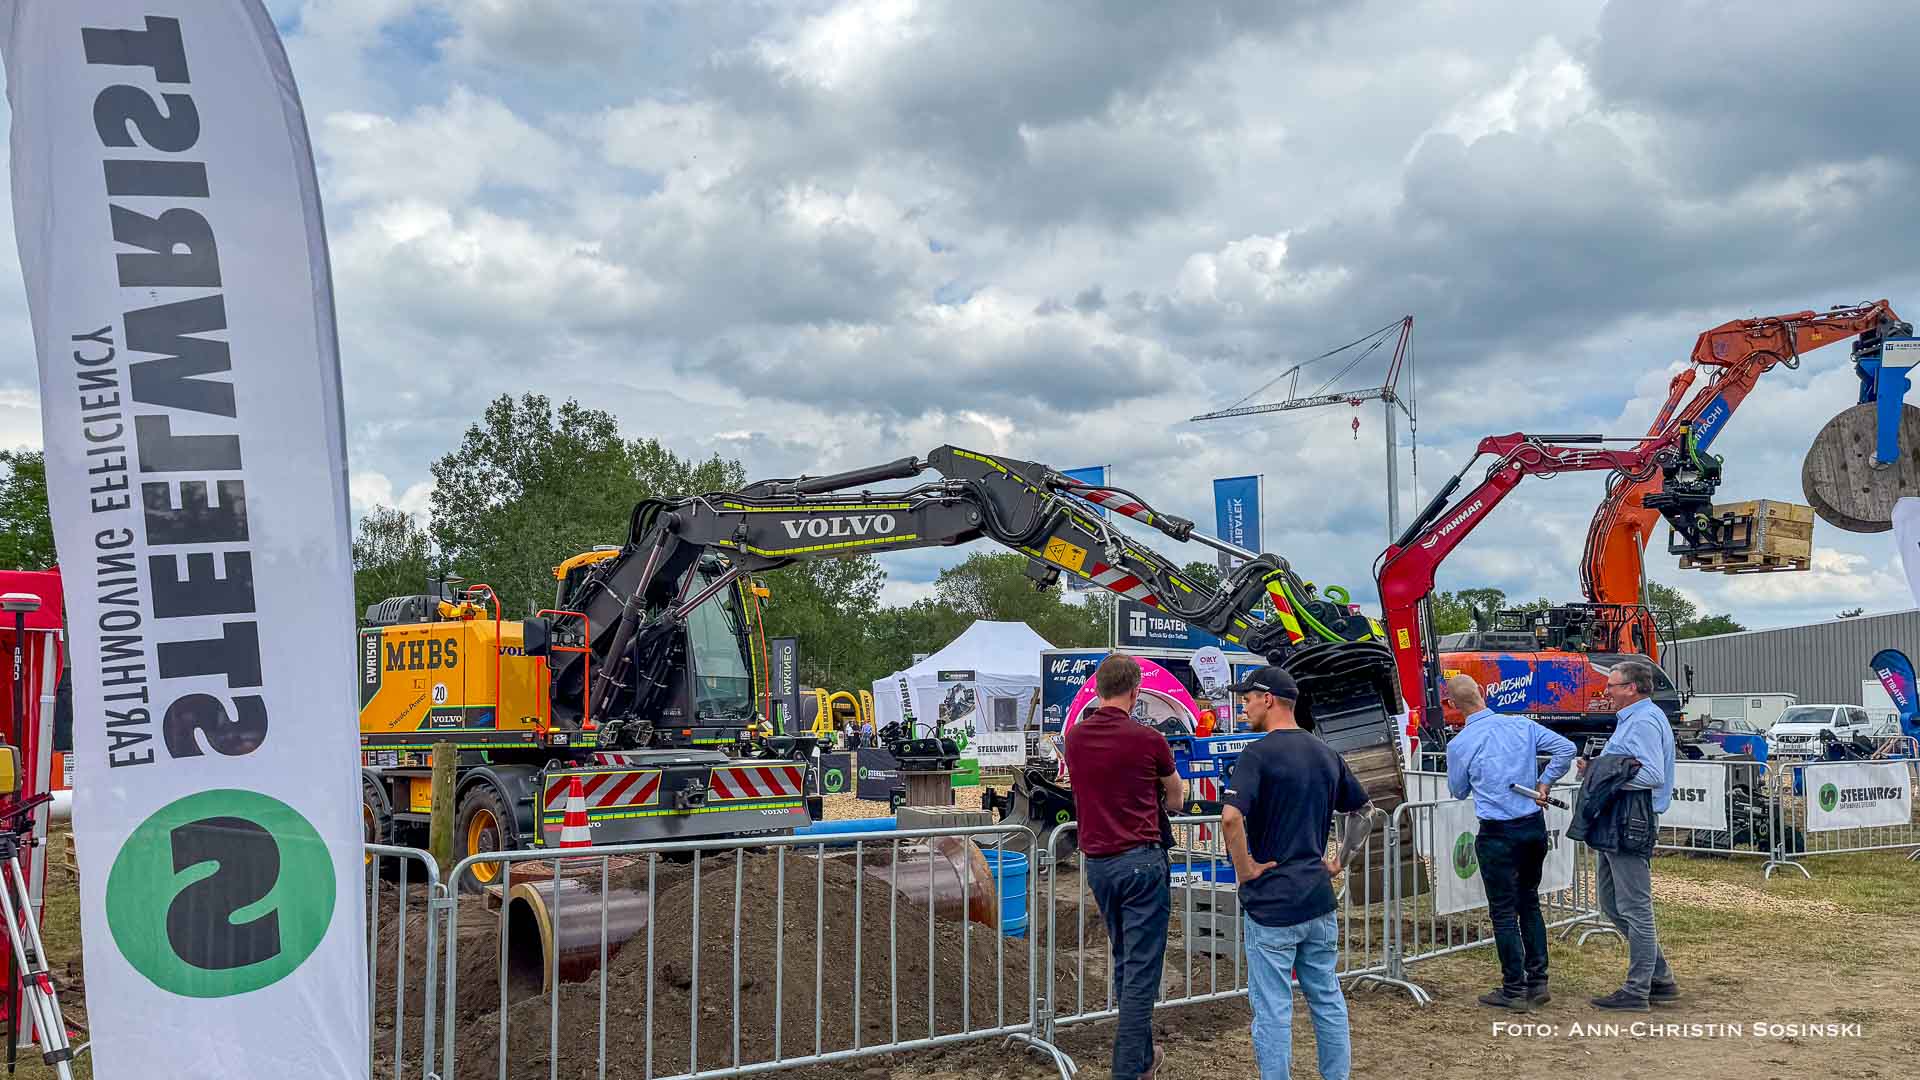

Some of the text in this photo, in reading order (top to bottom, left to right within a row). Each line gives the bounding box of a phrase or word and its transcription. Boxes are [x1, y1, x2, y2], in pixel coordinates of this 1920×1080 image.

[1695, 406, 1723, 440] ITACHI
[781, 513, 896, 539] VOLVO
[1438, 500, 1483, 536] YANMAR
[1148, 617, 1188, 632] TIBATEK
[386, 638, 458, 672] MHBS
[1050, 659, 1071, 674] WE
[1486, 671, 1533, 698] ROADSHOW
[1886, 678, 1908, 706] TIBATEK
[434, 686, 446, 702] 20
[1497, 689, 1527, 707] 2024
[977, 745, 1019, 753] STEELWRIST
[1840, 787, 1902, 802] STEELWRIST
[760, 808, 790, 816] VOLVO
